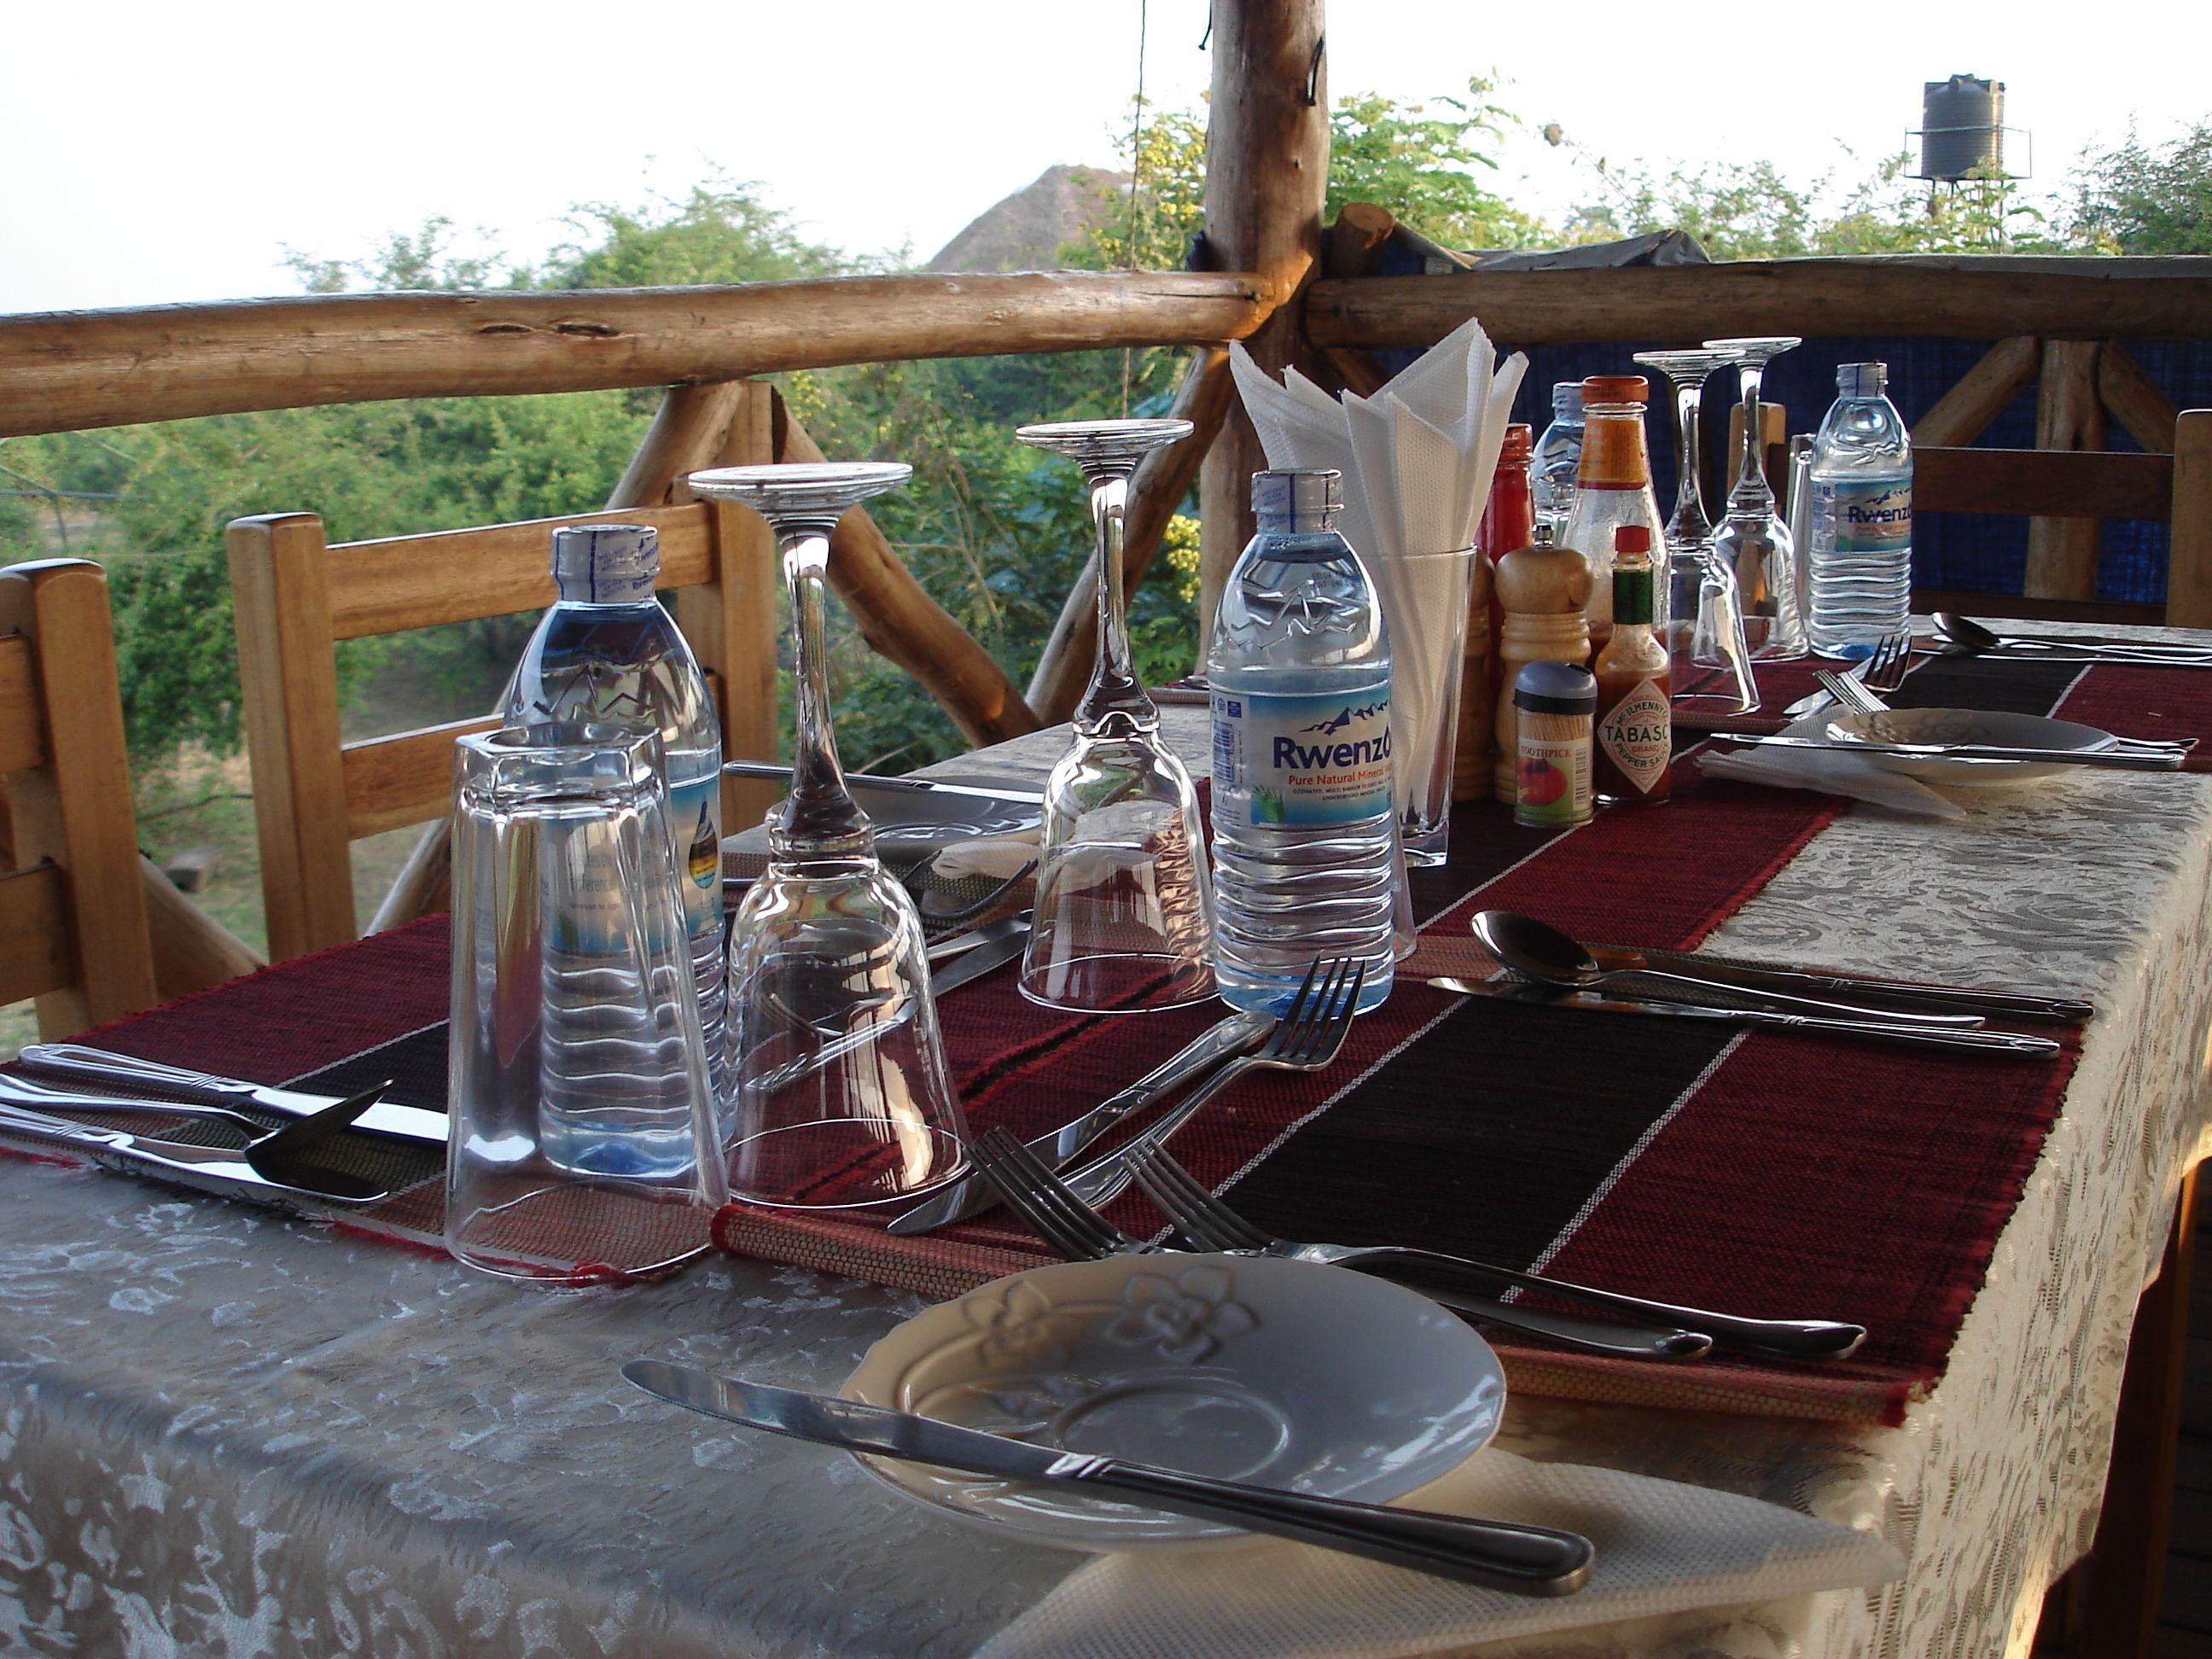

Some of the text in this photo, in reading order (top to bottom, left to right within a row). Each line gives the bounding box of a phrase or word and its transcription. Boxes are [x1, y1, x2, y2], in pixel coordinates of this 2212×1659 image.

[1289, 775, 1313, 785] Pure
[1317, 771, 1355, 785] Natural
[1358, 766, 1384, 781] Mineral
